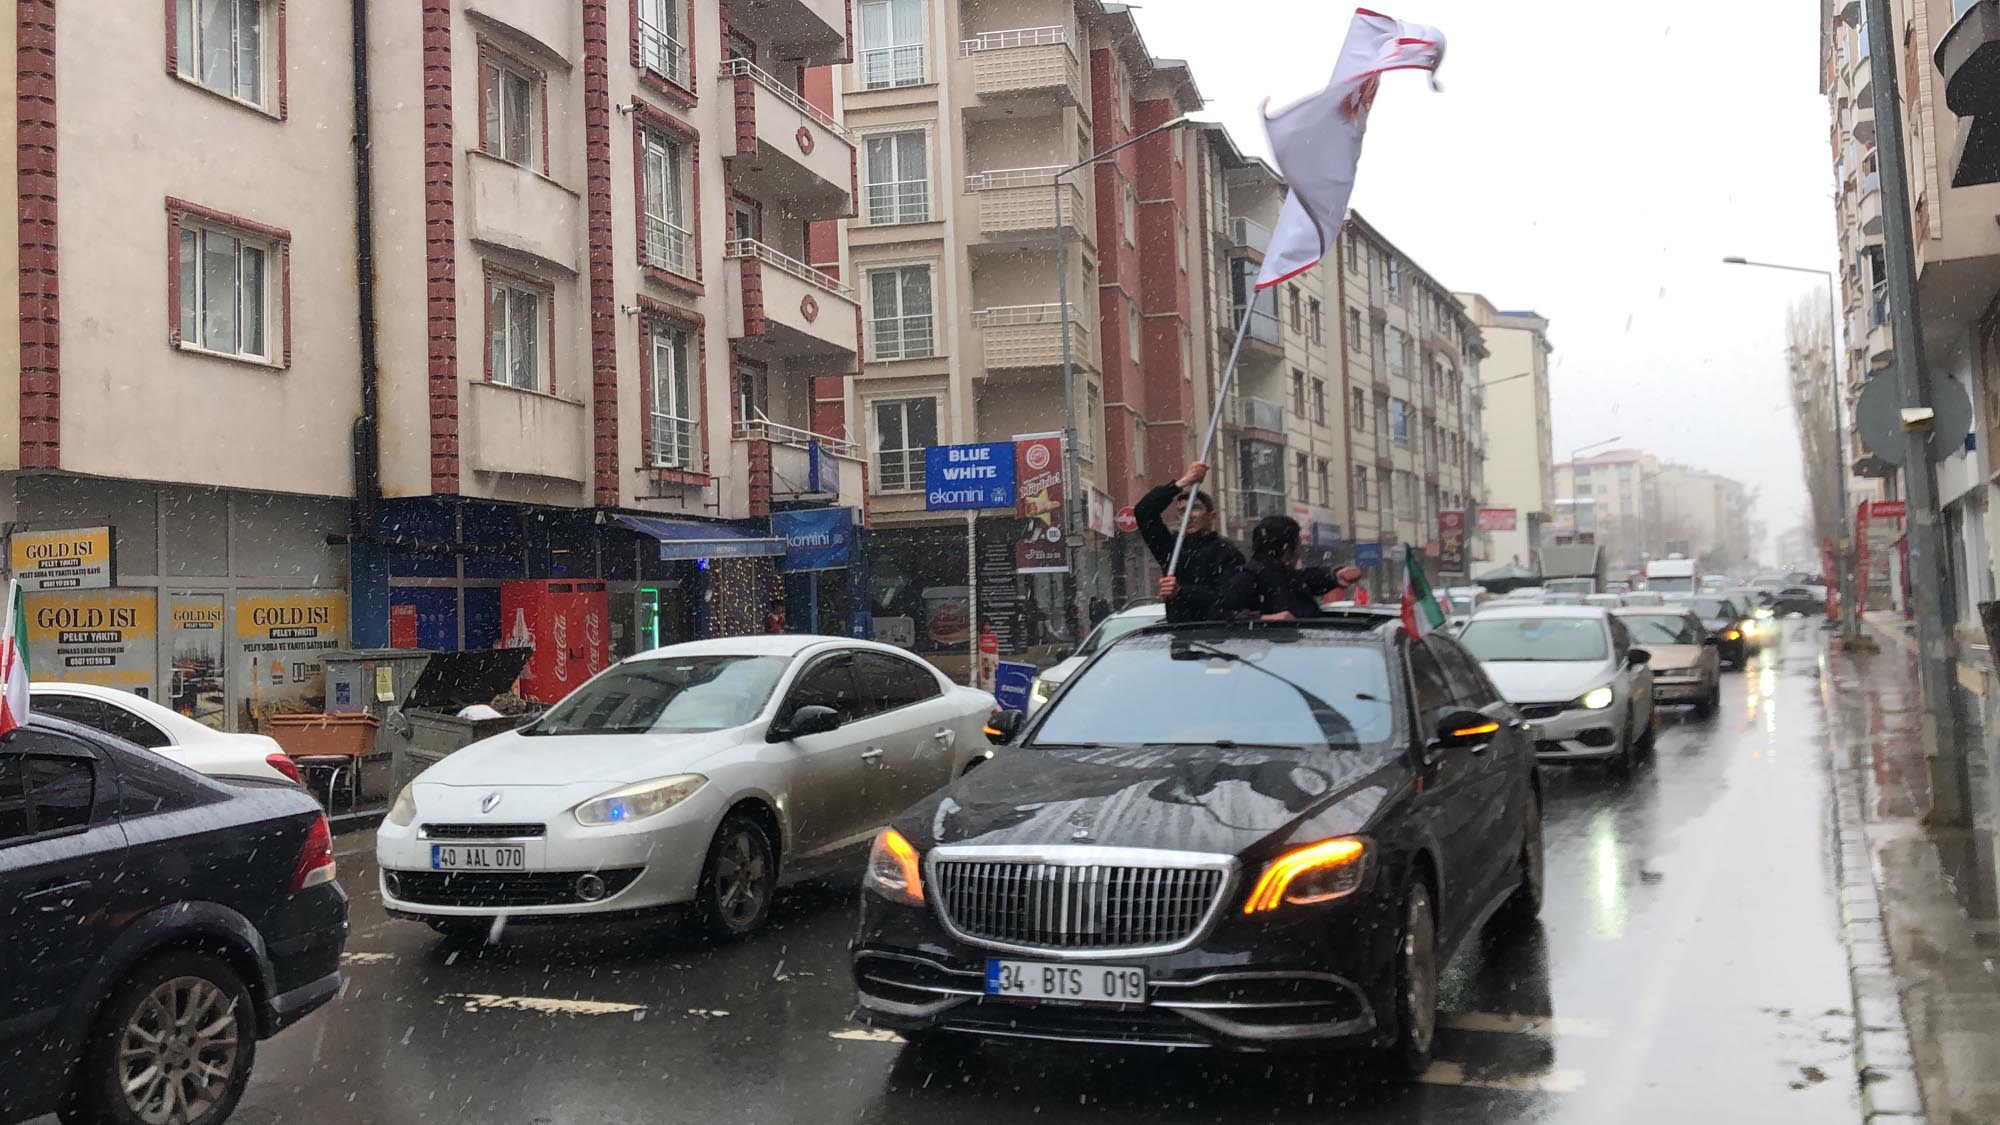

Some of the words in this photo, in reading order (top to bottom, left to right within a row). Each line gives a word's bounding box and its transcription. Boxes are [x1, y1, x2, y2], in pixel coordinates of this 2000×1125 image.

[949, 448, 990, 462] BLUE
[930, 486, 984, 504] ekomini
[786, 532, 830, 548] komini
[26, 543, 70, 558] GOLD
[74, 542, 92, 556] ISI
[38, 608, 103, 628] GOLD
[109, 608, 136, 628] ISI
[174, 611, 205, 620] GOLD
[208, 611, 221, 621] ISI
[253, 607, 303, 626] GOLD
[63, 633, 88, 641] PELET
[91, 632, 118, 641] YAKITI
[273, 629, 291, 637] PELET
[441, 848, 456, 866] 40
[466, 849, 490, 867] AAL
[496, 849, 521, 866] 070
[1001, 965, 1024, 992] 34
[1043, 967, 1082, 995] BTS
[1104, 970, 1141, 998] 019
